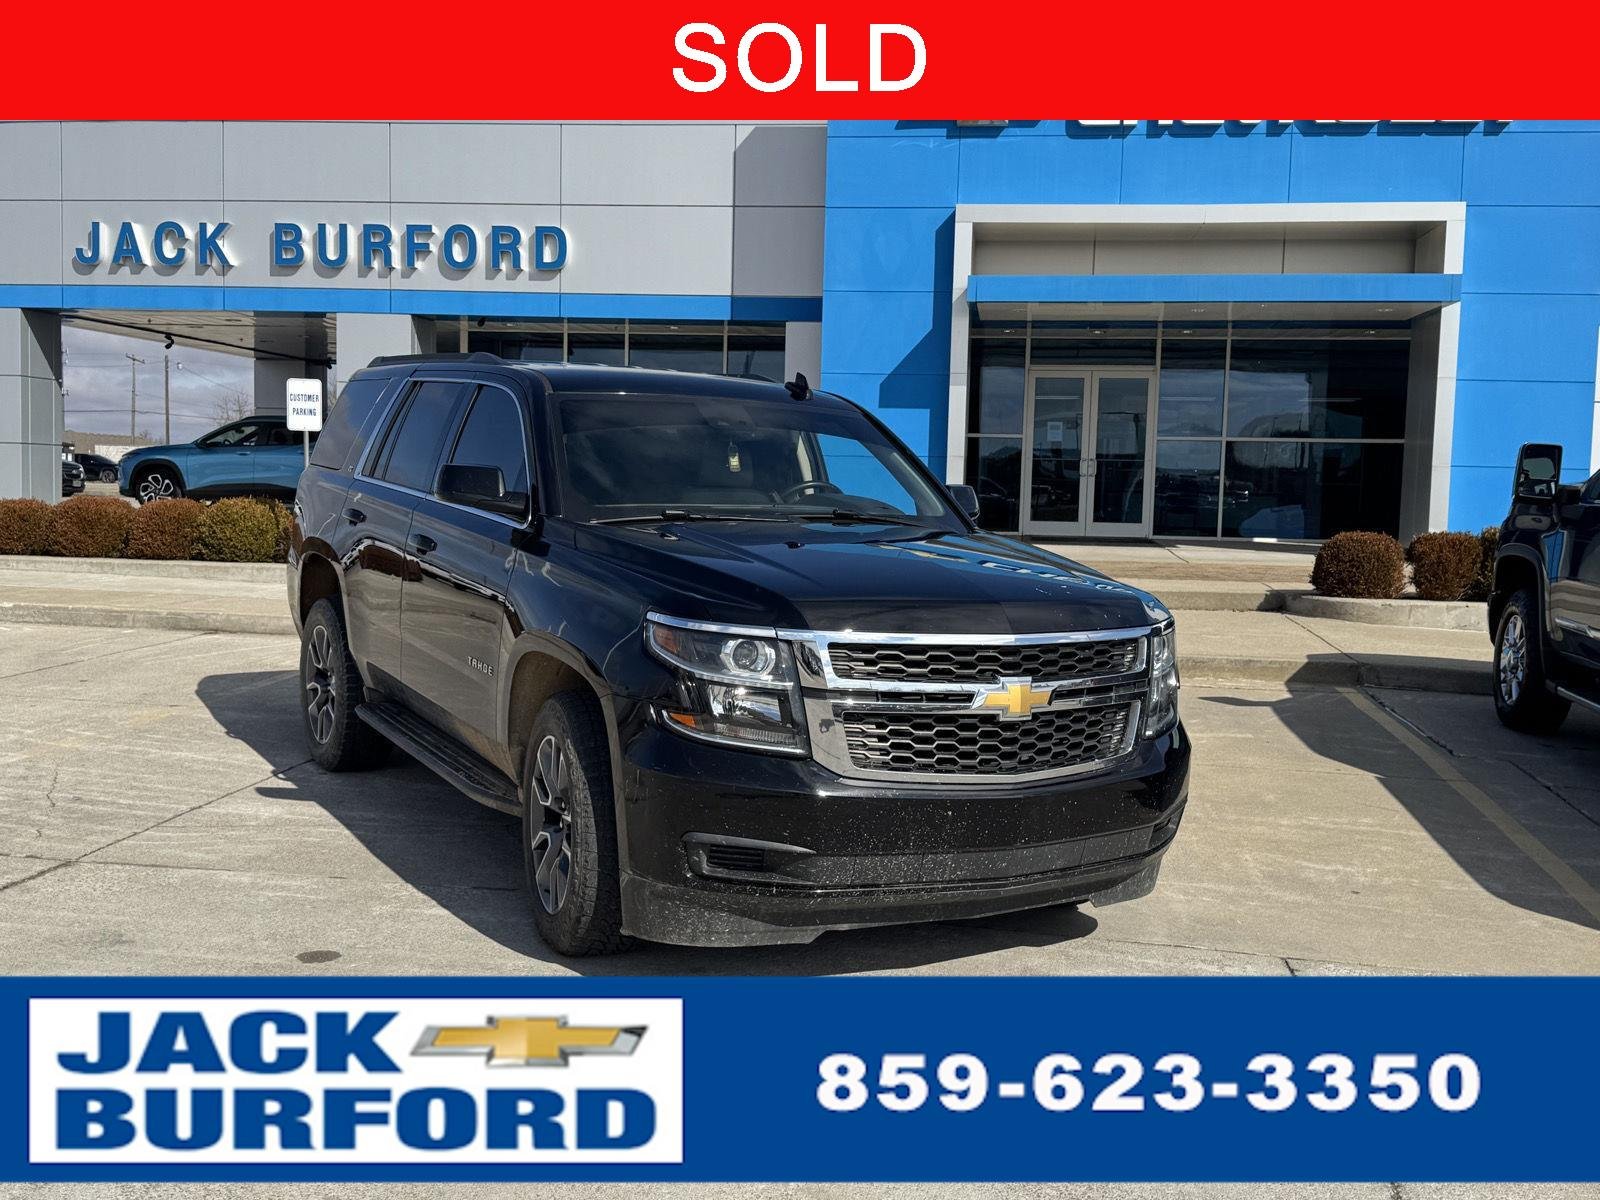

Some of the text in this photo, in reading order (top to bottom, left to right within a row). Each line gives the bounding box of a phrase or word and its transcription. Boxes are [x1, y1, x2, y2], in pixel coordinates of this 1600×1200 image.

[75, 220, 569, 272] JACK BURFORD
[289, 393, 320, 402] CUSTOMER
[292, 407, 317, 416] PARKING
[467, 656, 493, 677] TAHOE
